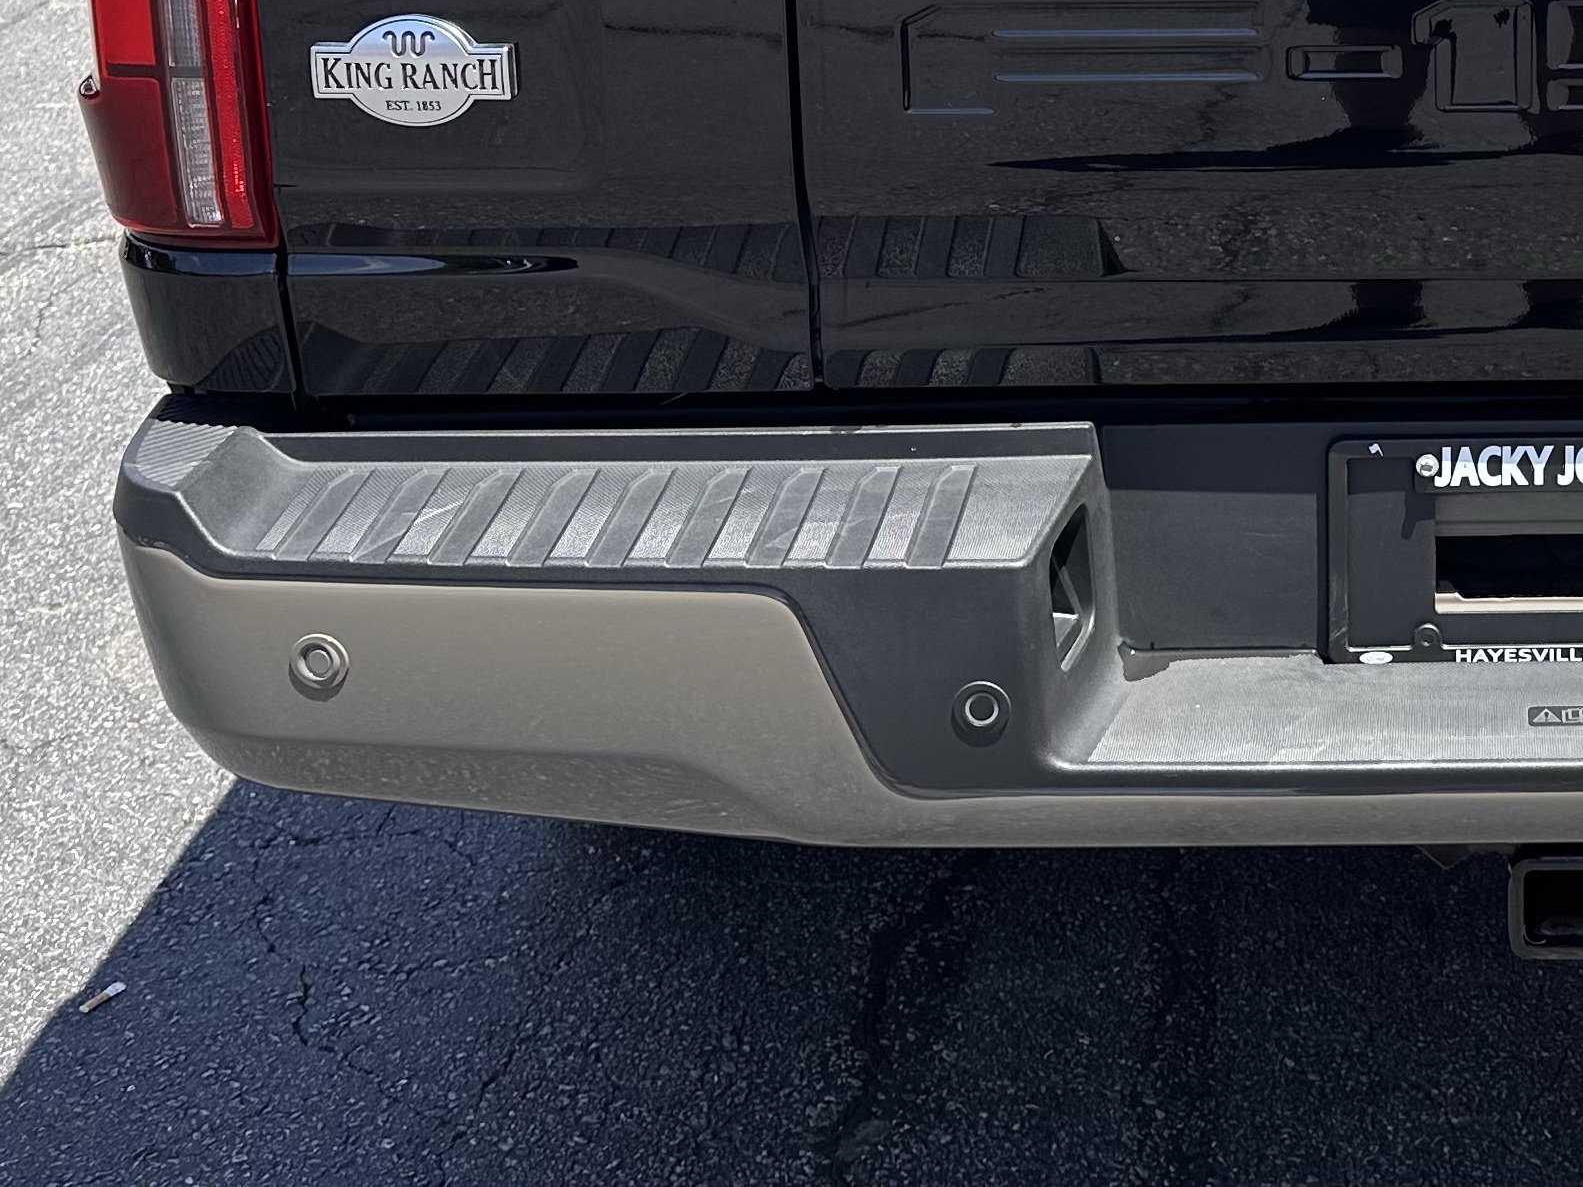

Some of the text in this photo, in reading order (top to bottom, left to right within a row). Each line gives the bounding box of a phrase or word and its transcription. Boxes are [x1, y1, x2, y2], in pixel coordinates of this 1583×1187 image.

[320, 57, 500, 91] KING RANCH
[386, 100, 442, 112] EST. 1853
[1434, 445, 1554, 488] JACKY
